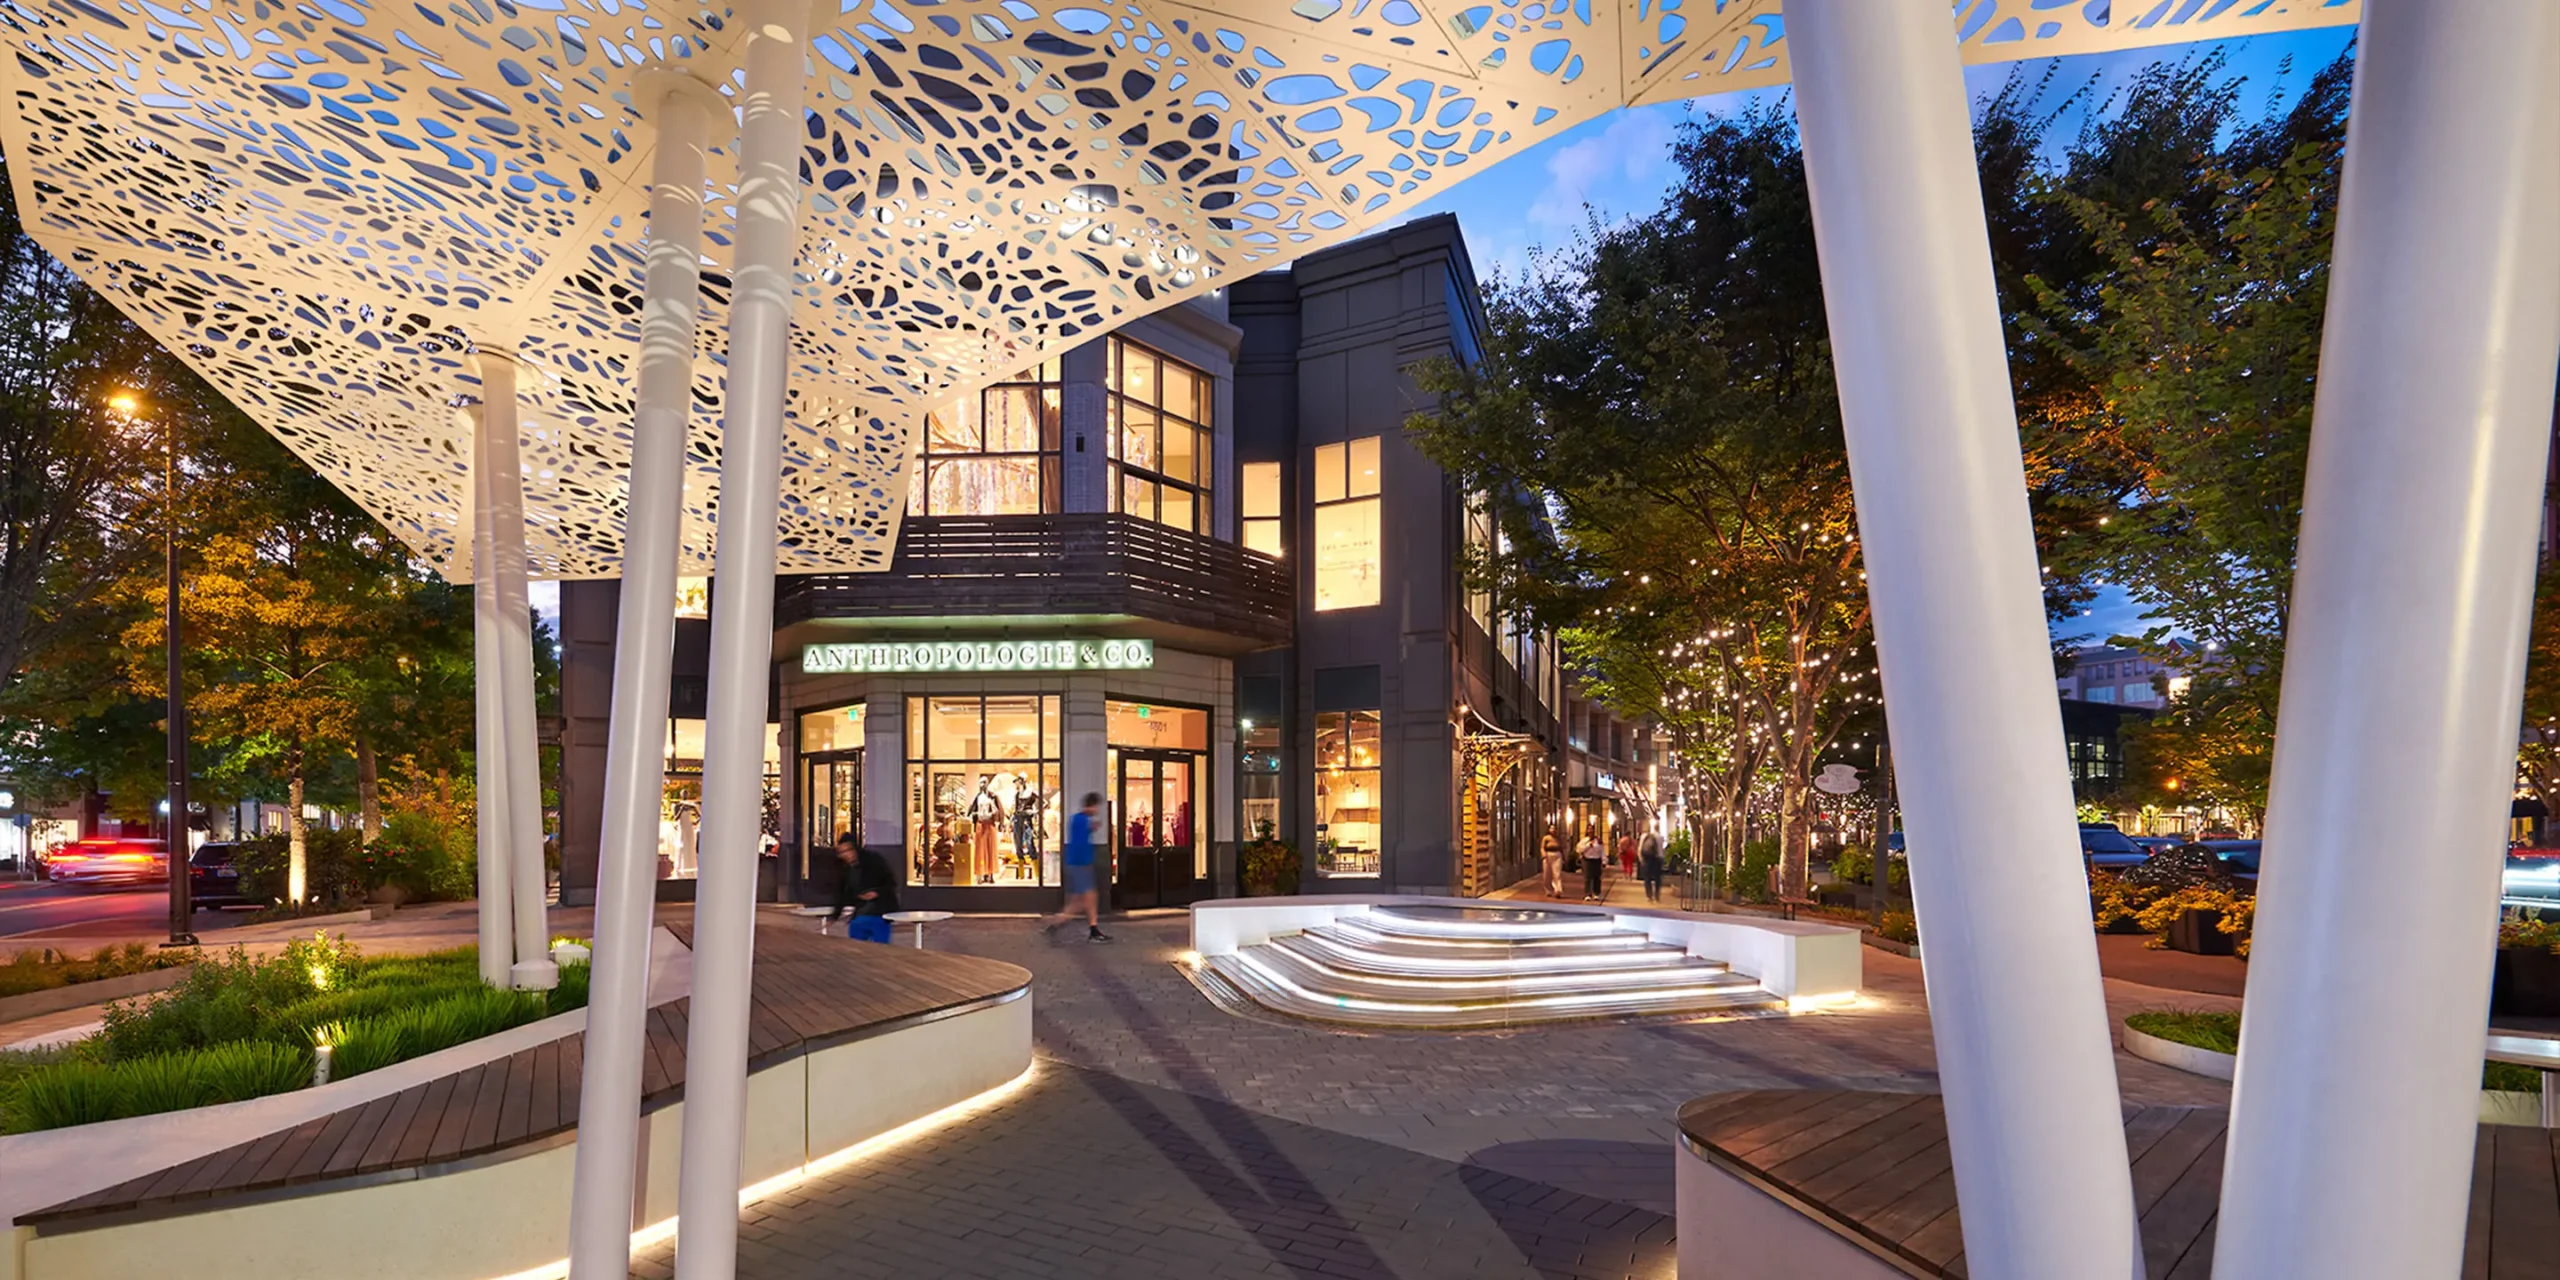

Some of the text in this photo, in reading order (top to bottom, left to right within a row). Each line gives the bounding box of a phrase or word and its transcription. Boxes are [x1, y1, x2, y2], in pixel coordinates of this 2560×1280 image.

[804, 644, 1151, 667] ANTHROPOLOGIE & CO.
